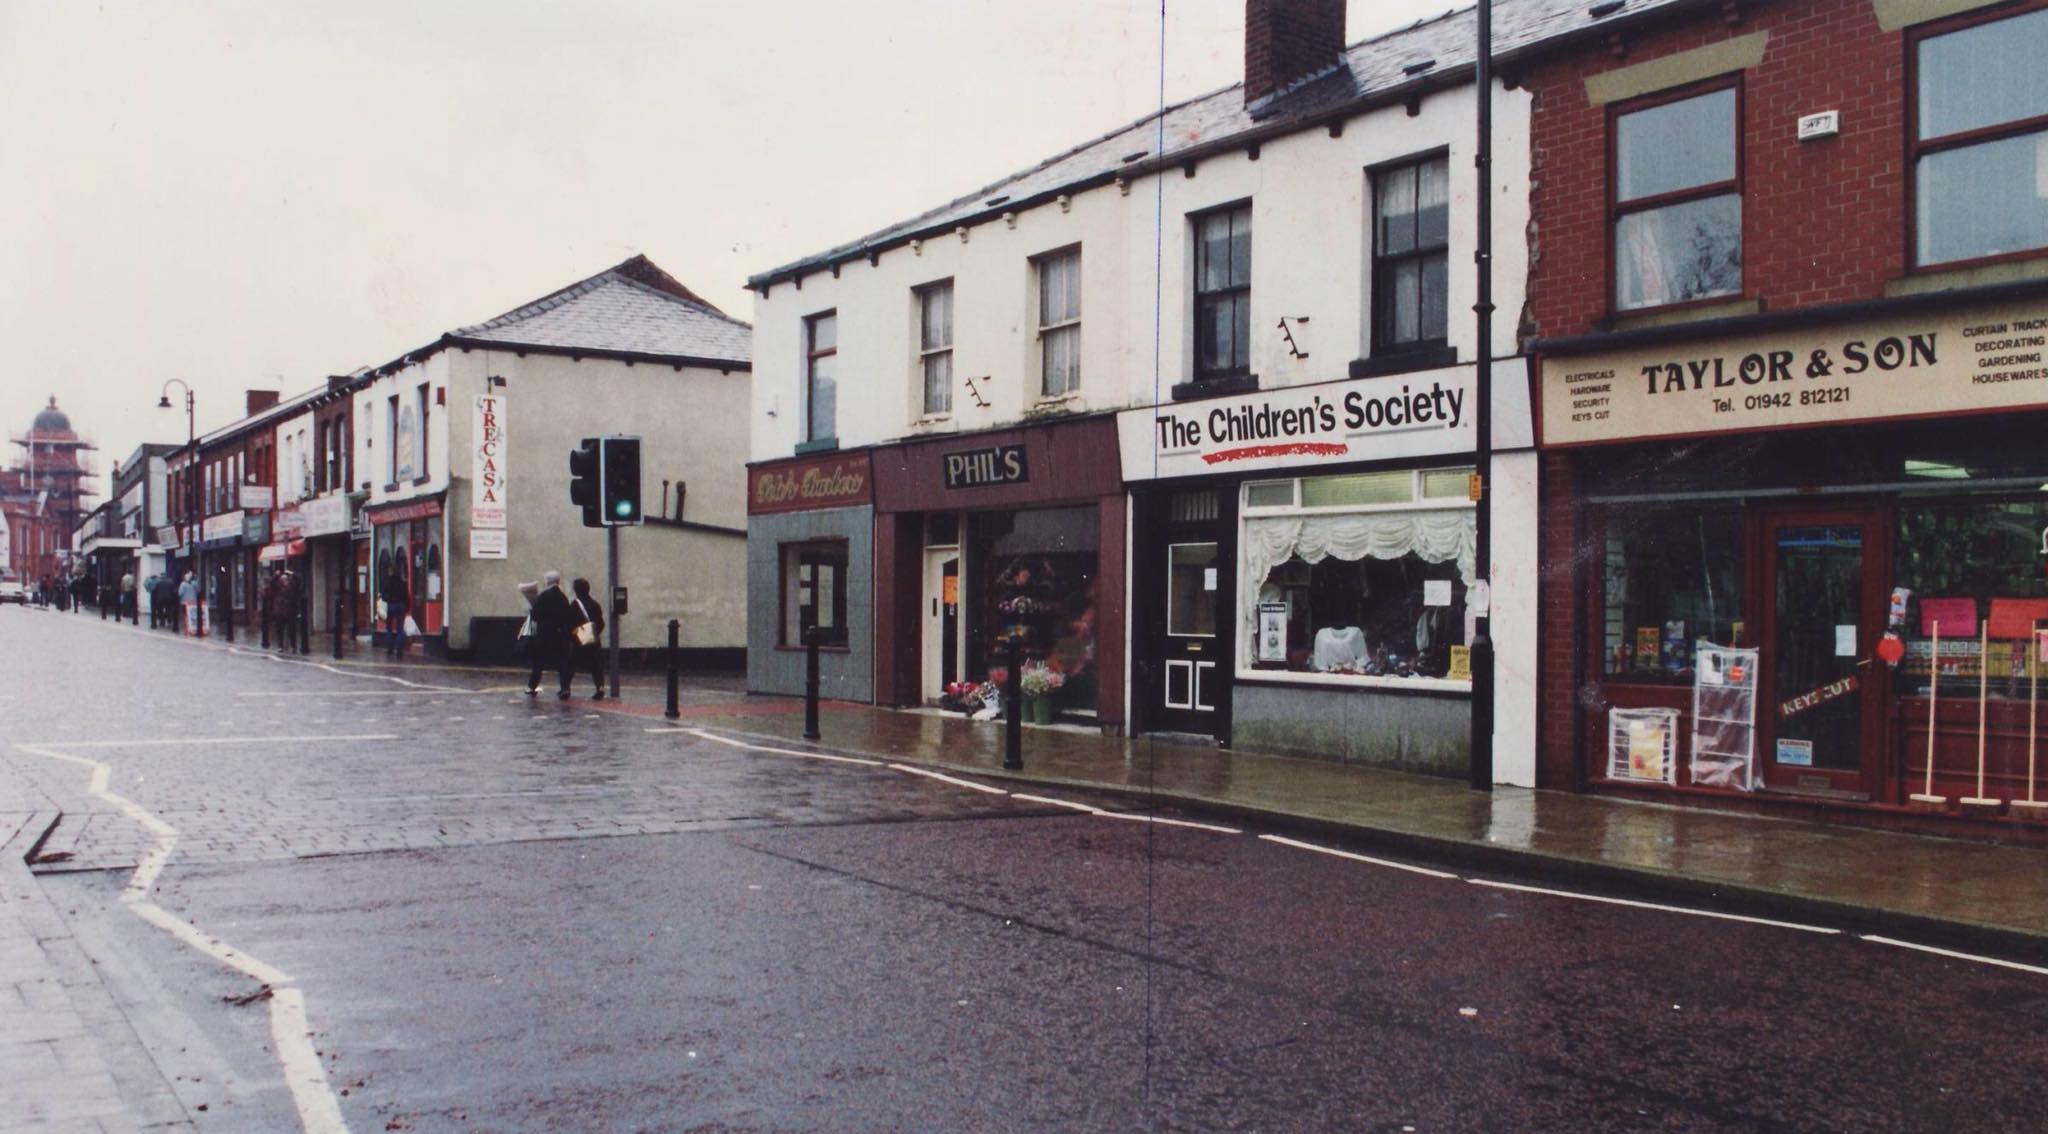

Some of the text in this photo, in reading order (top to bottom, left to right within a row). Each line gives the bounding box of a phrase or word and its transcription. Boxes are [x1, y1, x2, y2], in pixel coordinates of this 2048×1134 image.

[1962, 323, 2008, 338] CURTAIN
[1975, 336, 2046, 353] DECORATING
[1641, 333, 1938, 395] TAYLOR & SON
[1978, 352, 2041, 368] GARDENING
[1565, 369, 1615, 383] ELECTRICALS
[1972, 368, 2048, 384] HOUSEWARES
[1570, 383, 1611, 396] HARDWARE
[1573, 398, 1610, 409] SECURITY
[1712, 387, 1850, 413] Tel. 01942 812121
[1156, 382, 1464, 448] The Children's Society
[1572, 410, 1610, 422] KEYS CUT
[483, 398, 496, 502] TRECASA
[947, 447, 1020, 485] PHIL'S
[1783, 690, 1819, 715] KEYS
